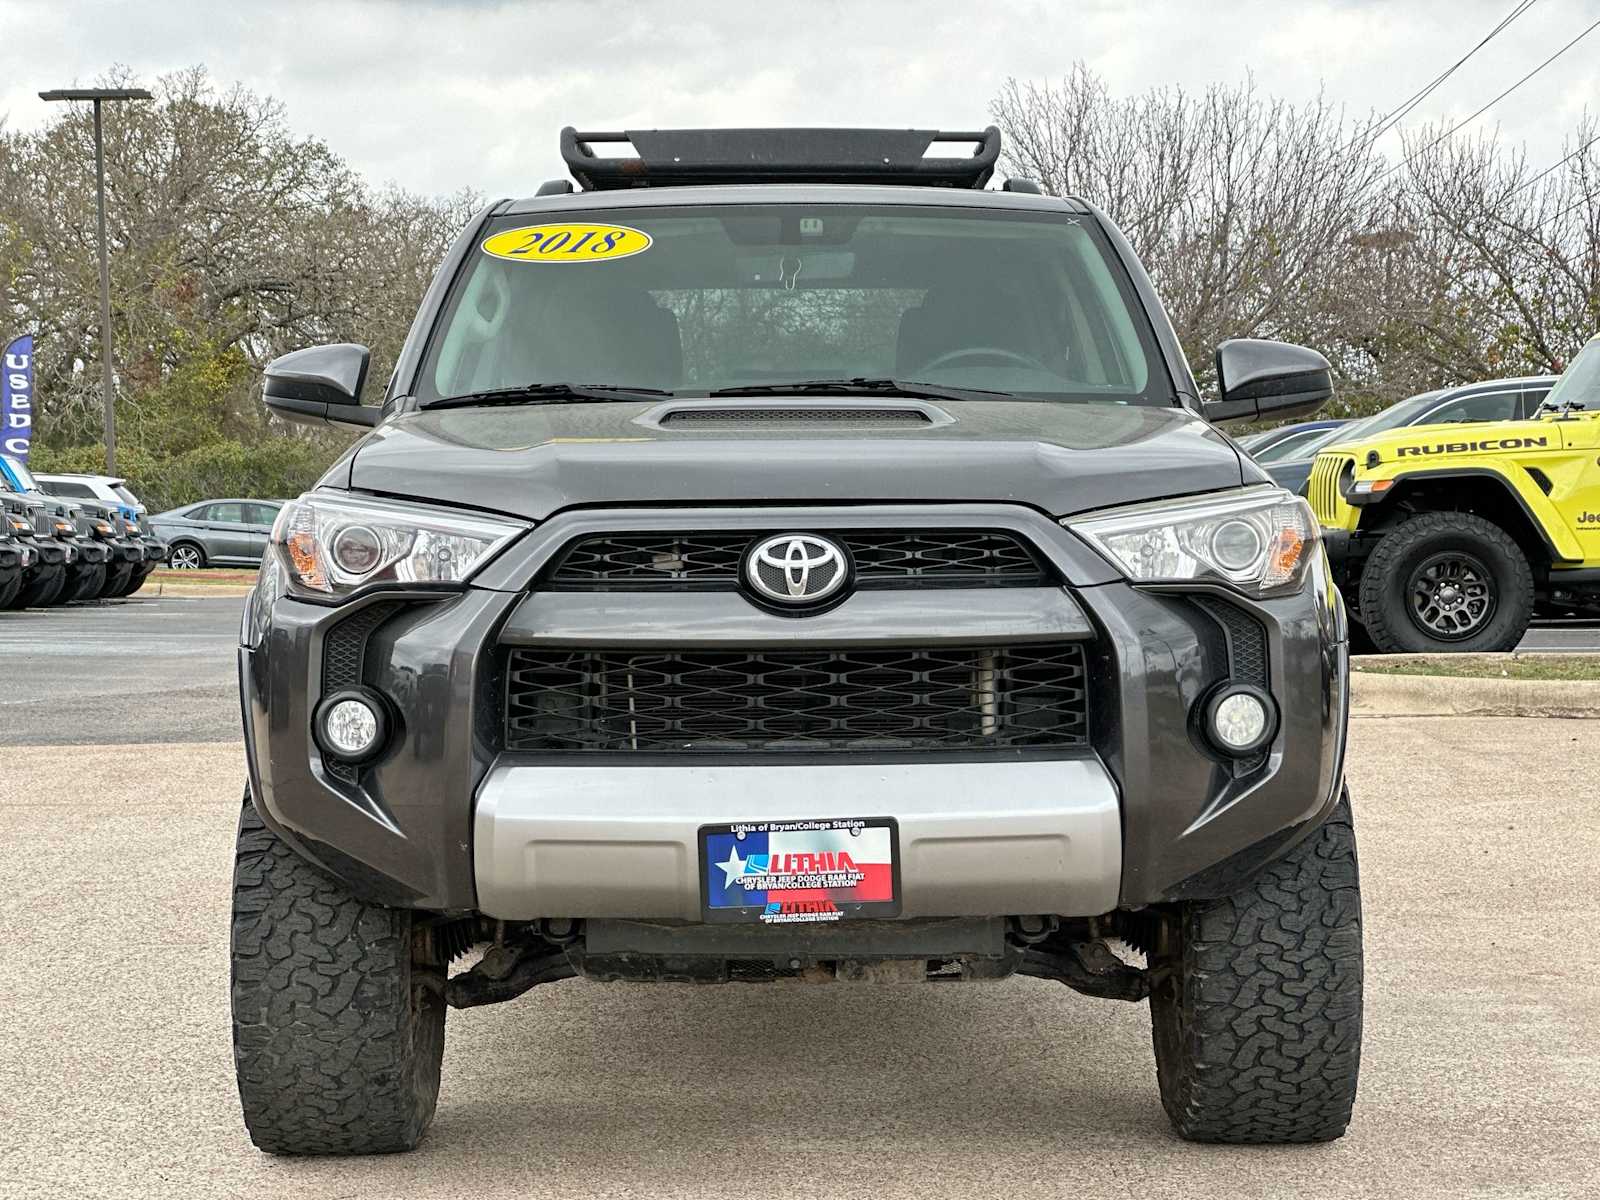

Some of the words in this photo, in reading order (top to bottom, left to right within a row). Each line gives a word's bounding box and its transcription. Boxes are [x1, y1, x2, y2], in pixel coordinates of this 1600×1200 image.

[507, 231, 626, 254] 2018
[5, 353, 31, 428] USED
[1397, 437, 1547, 457] RUBICON
[731, 824, 756, 832] Lithia
[758, 823, 768, 832] of
[770, 821, 831, 833] Bryan/College
[832, 819, 865, 829] Station
[769, 851, 858, 874] LITHIA
[736, 876, 776, 885] CHRYSLER
[778, 875, 796, 883] JEEP
[797, 874, 827, 882] DODGE
[828, 873, 847, 881] RAM
[848, 872, 865, 880] FIAT
[823, 880, 857, 888] STATION
[782, 900, 838, 914] LITHIA
